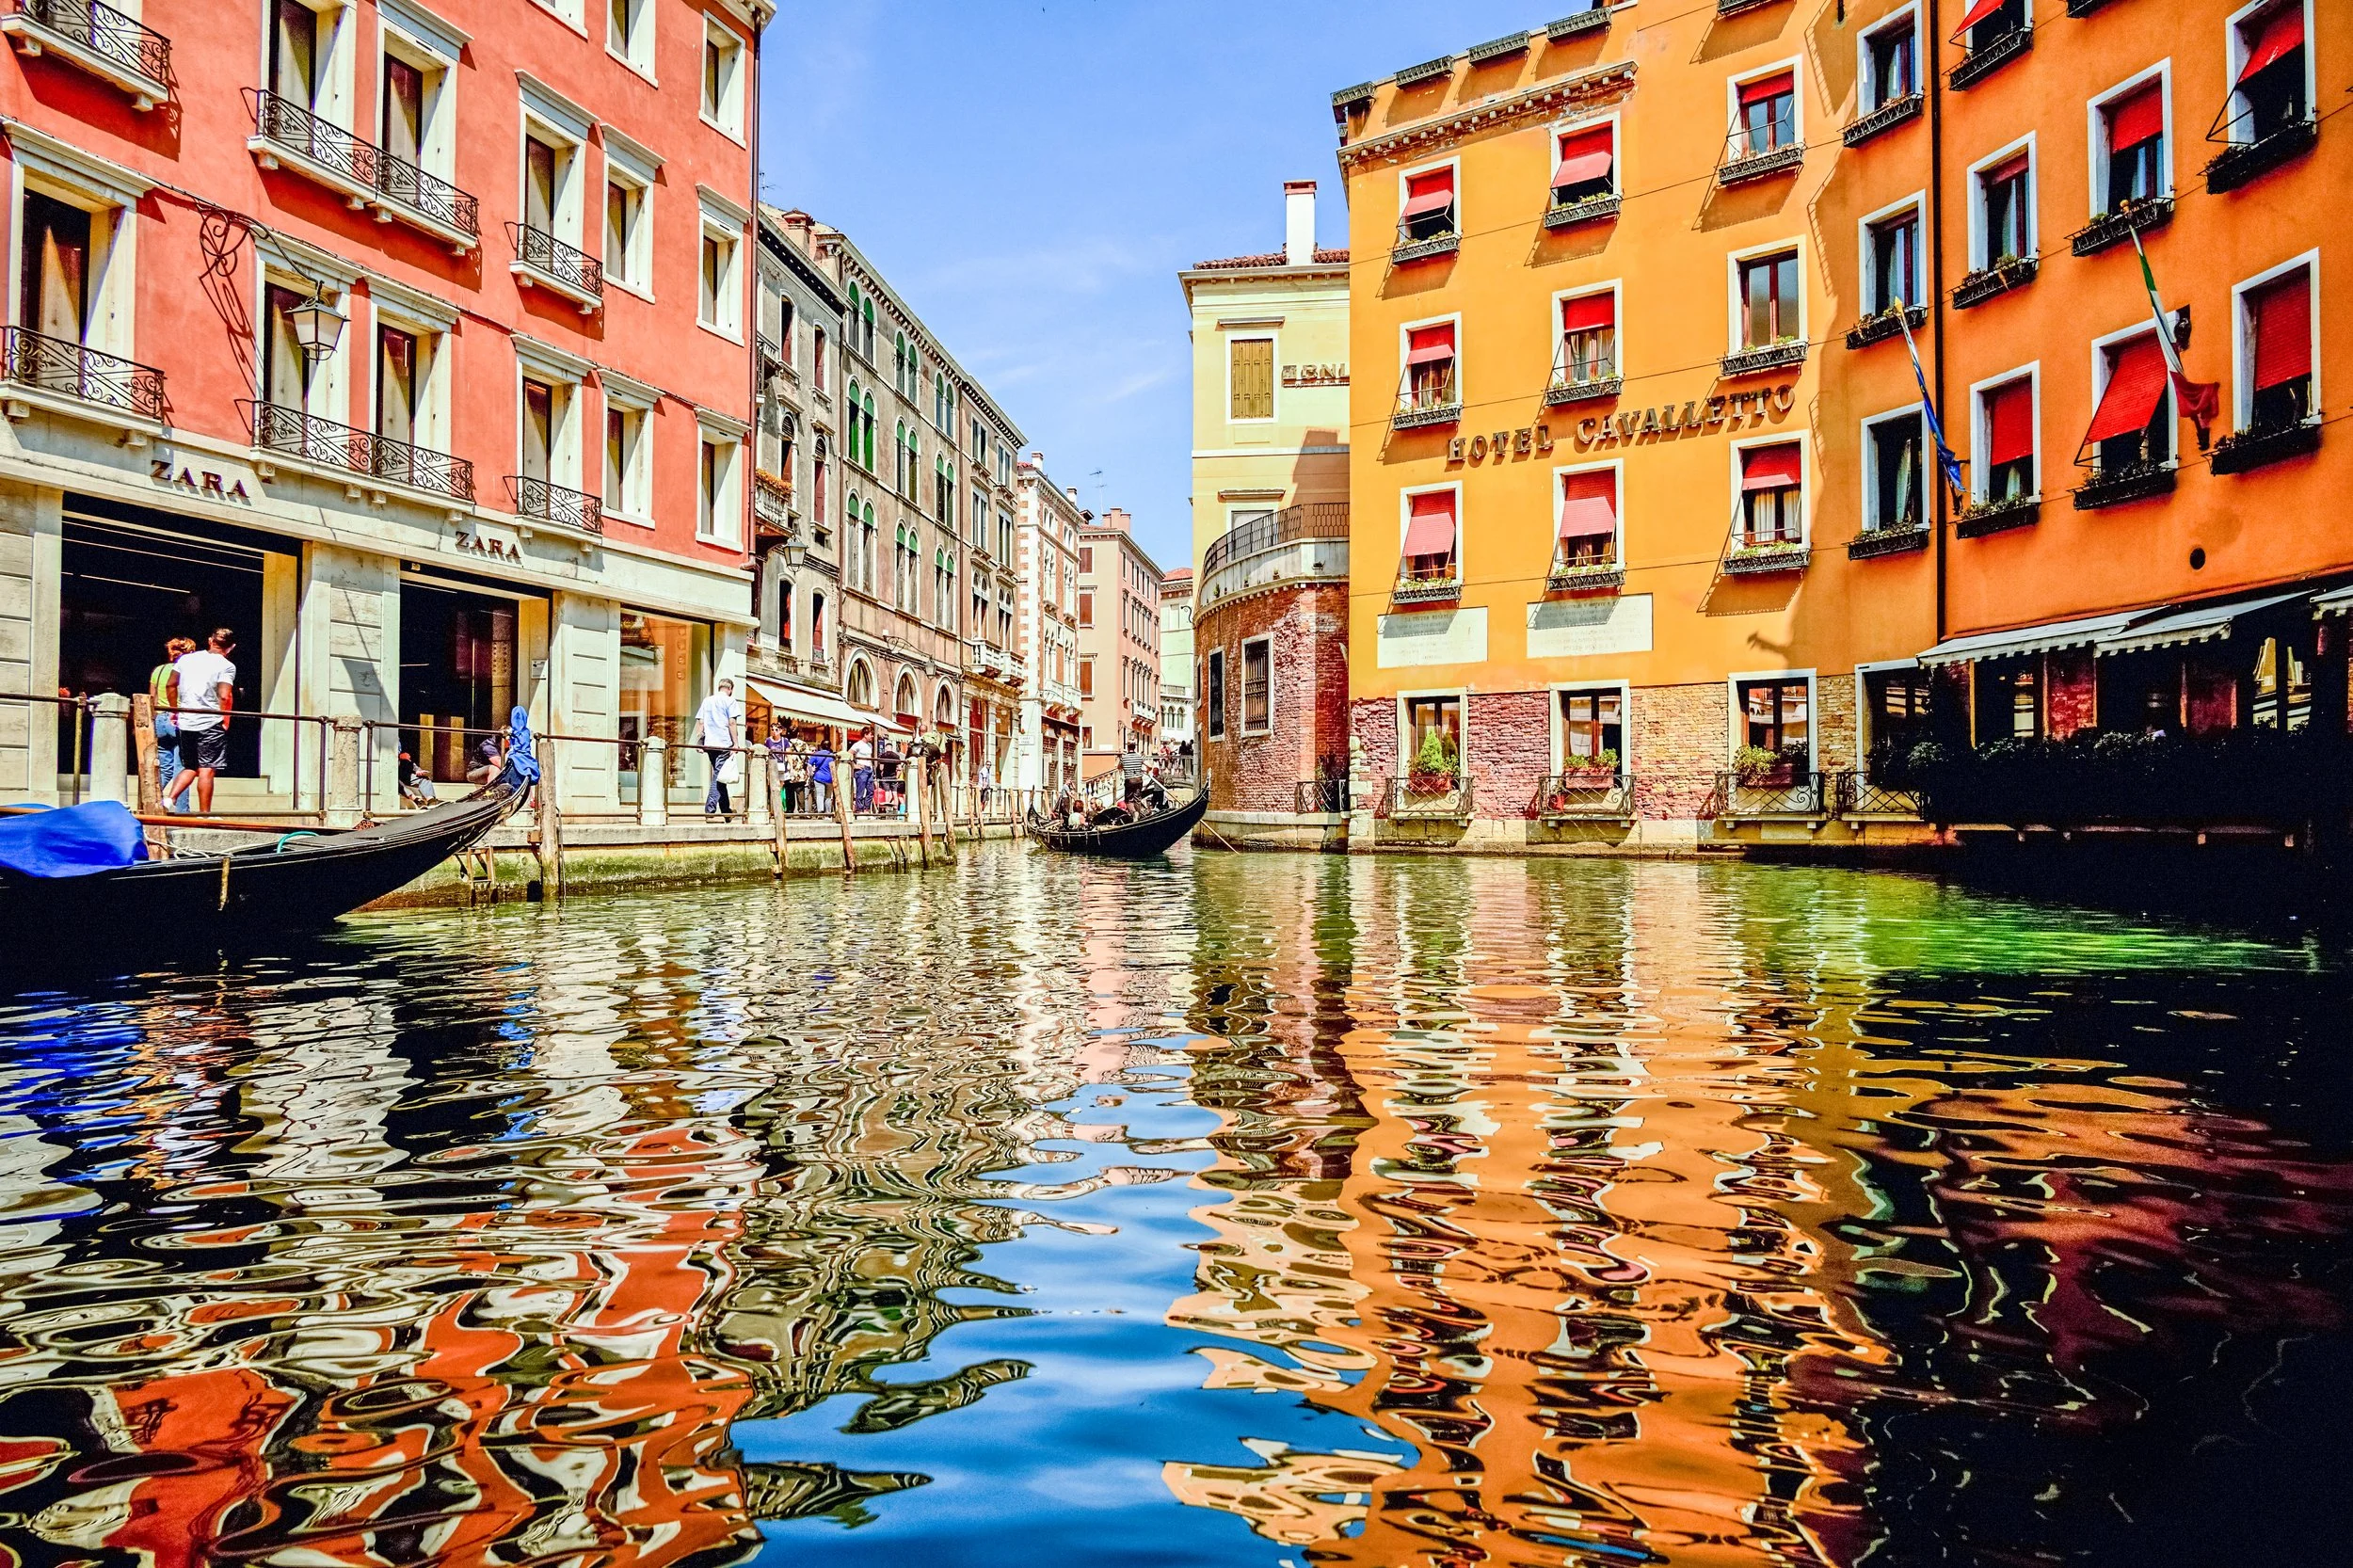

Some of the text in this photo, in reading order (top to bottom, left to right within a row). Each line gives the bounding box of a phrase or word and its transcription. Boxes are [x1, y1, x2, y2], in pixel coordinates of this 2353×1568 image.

[1448, 384, 1796, 462] HOTEL CAVALLETTO
[151, 459, 251, 498] ZARA
[456, 531, 521, 558] ZARA
